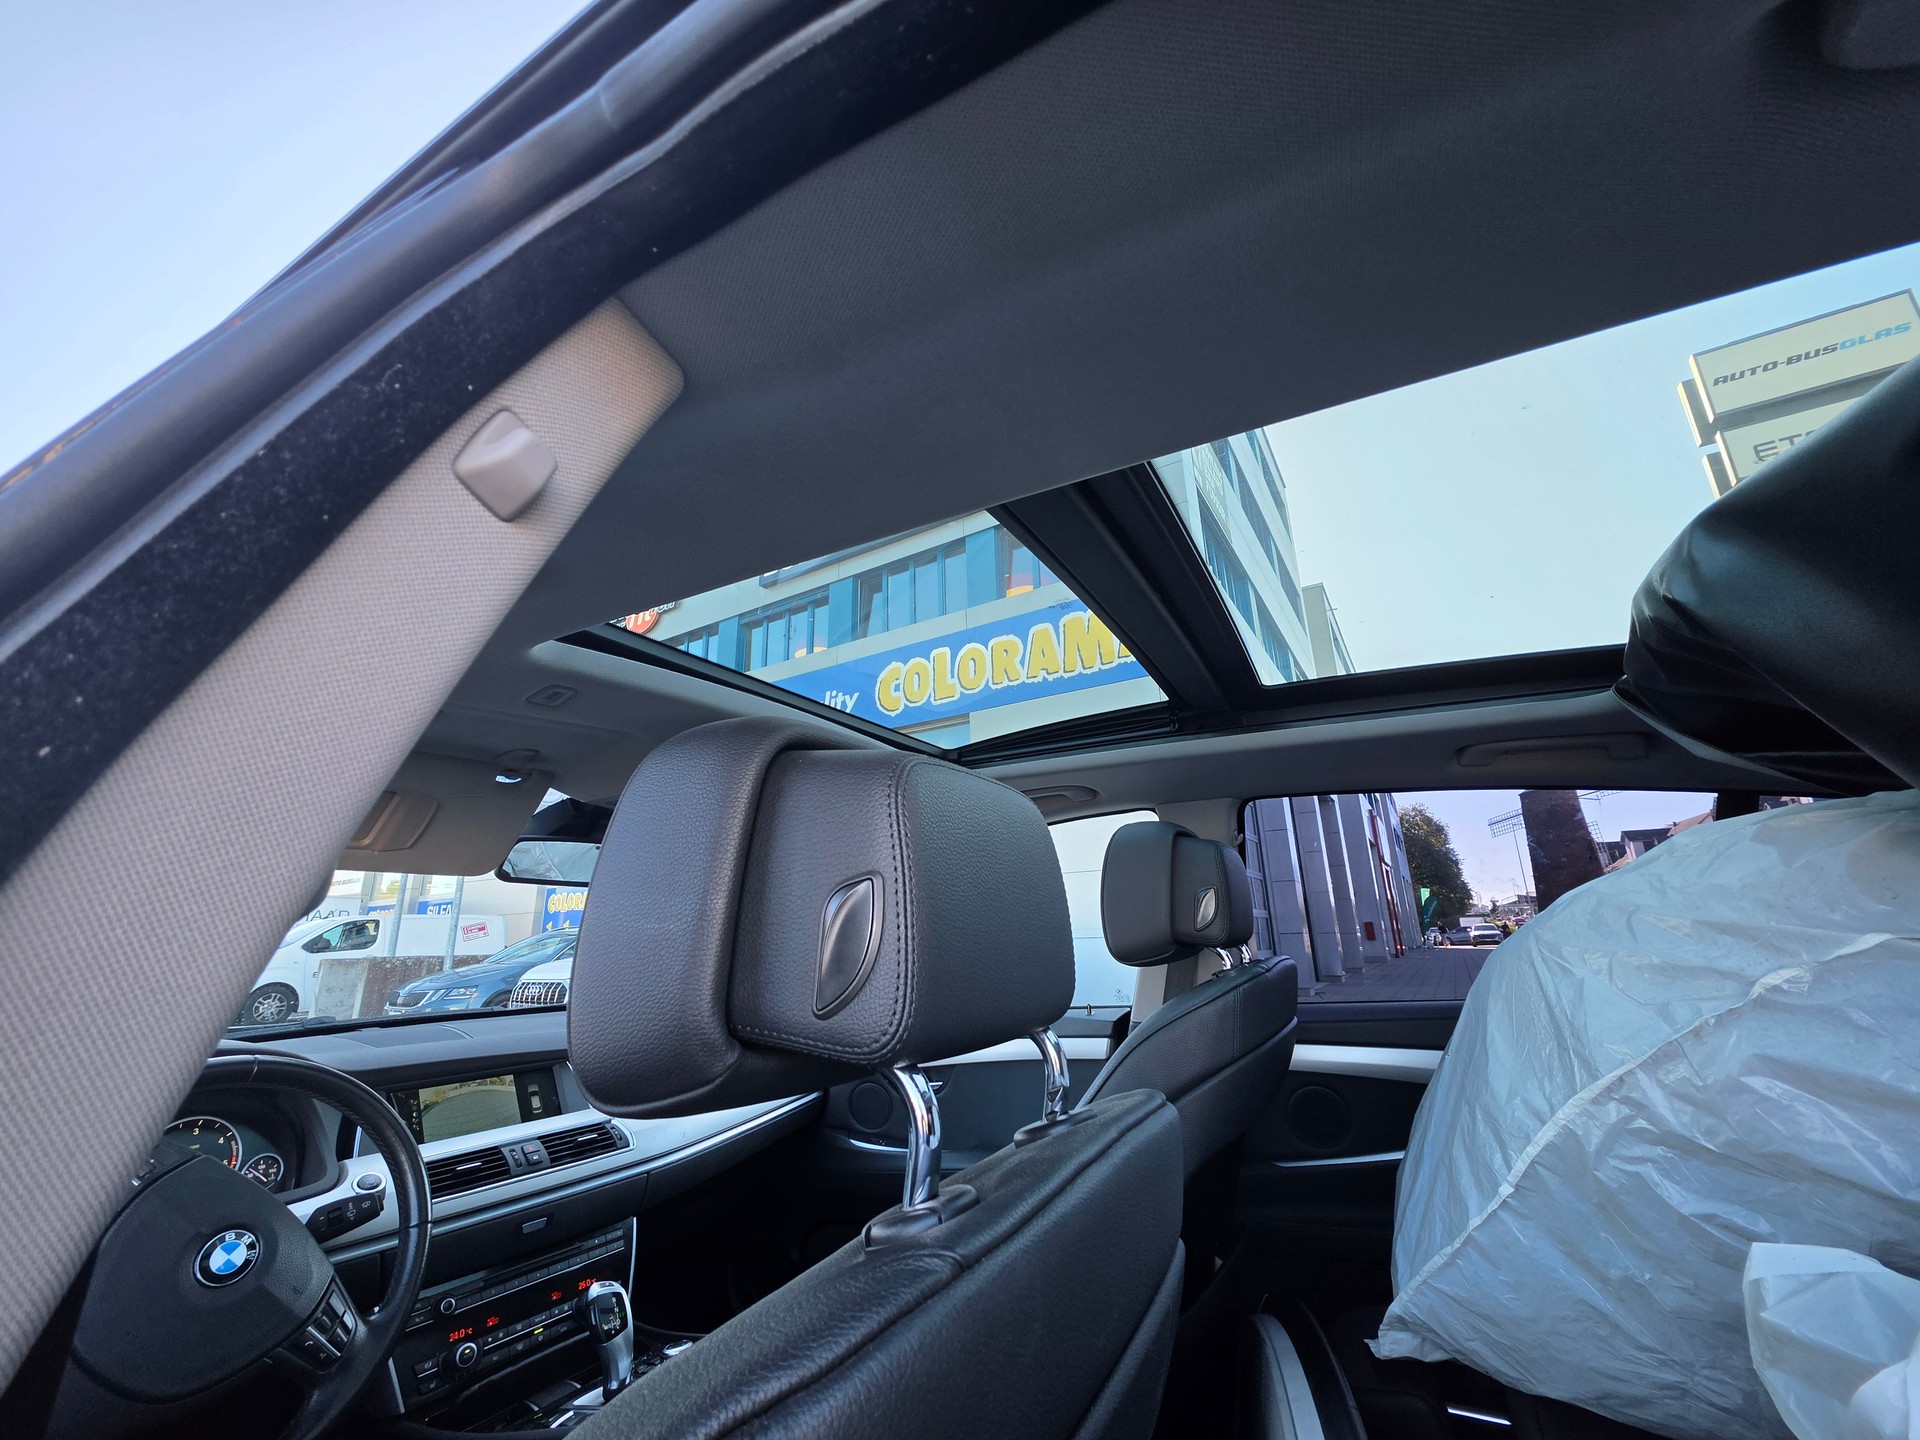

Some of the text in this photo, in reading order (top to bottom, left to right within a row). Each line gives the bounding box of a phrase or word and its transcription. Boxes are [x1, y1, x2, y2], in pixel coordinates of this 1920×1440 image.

[1713, 322, 1912, 387] AUTO-BUSGLAS
[1752, 429, 1818, 460] ET
[820, 690, 860, 714] lity
[193, 1127, 200, 1135] 3
[225, 1232, 257, 1260] BMW
